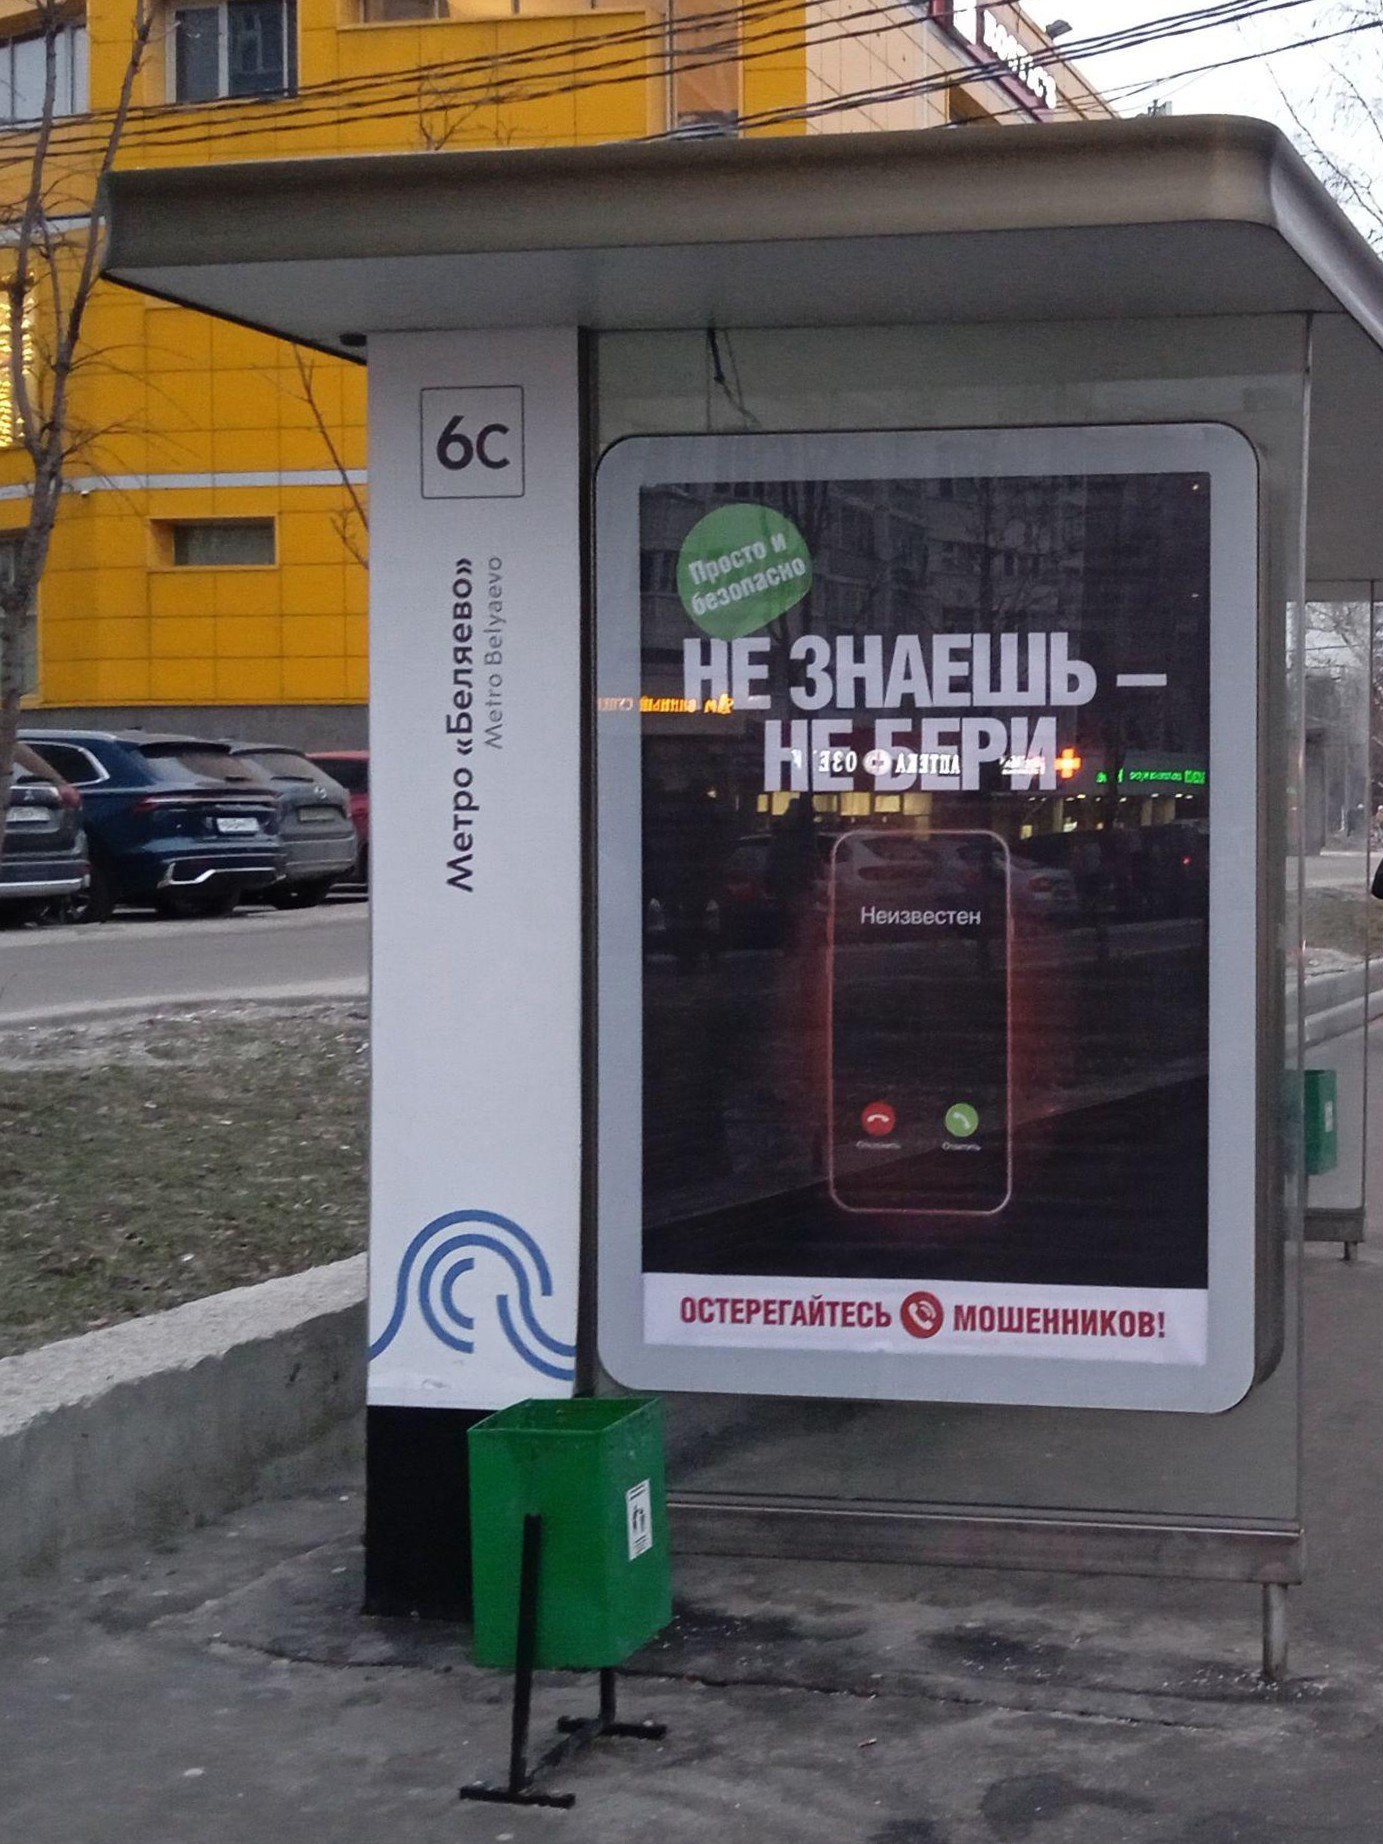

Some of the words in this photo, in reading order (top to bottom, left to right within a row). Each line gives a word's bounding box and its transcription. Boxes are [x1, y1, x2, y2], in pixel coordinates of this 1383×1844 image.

[688, 541, 767, 585] Просто
[771, 533, 787, 553] и
[691, 558, 806, 615] безопасно
[484, 556, 507, 665] Belyaevo
[446, 557, 473, 755] «Беляево»
[683, 637, 771, 711] НЕ
[789, 631, 1097, 710] ЗНАЕШЬ
[484, 673, 503, 750] Metro
[764, 719, 853, 791] НЕ
[874, 716, 1057, 791] БЕРИ
[446, 767, 480, 893] Метро
[860, 905, 981, 925] Неизвестен
[679, 1295, 892, 1329] ОСТЕРЕГАЙТЕСЬ
[953, 1304, 1167, 1338] МОШЕННИКОВ!
